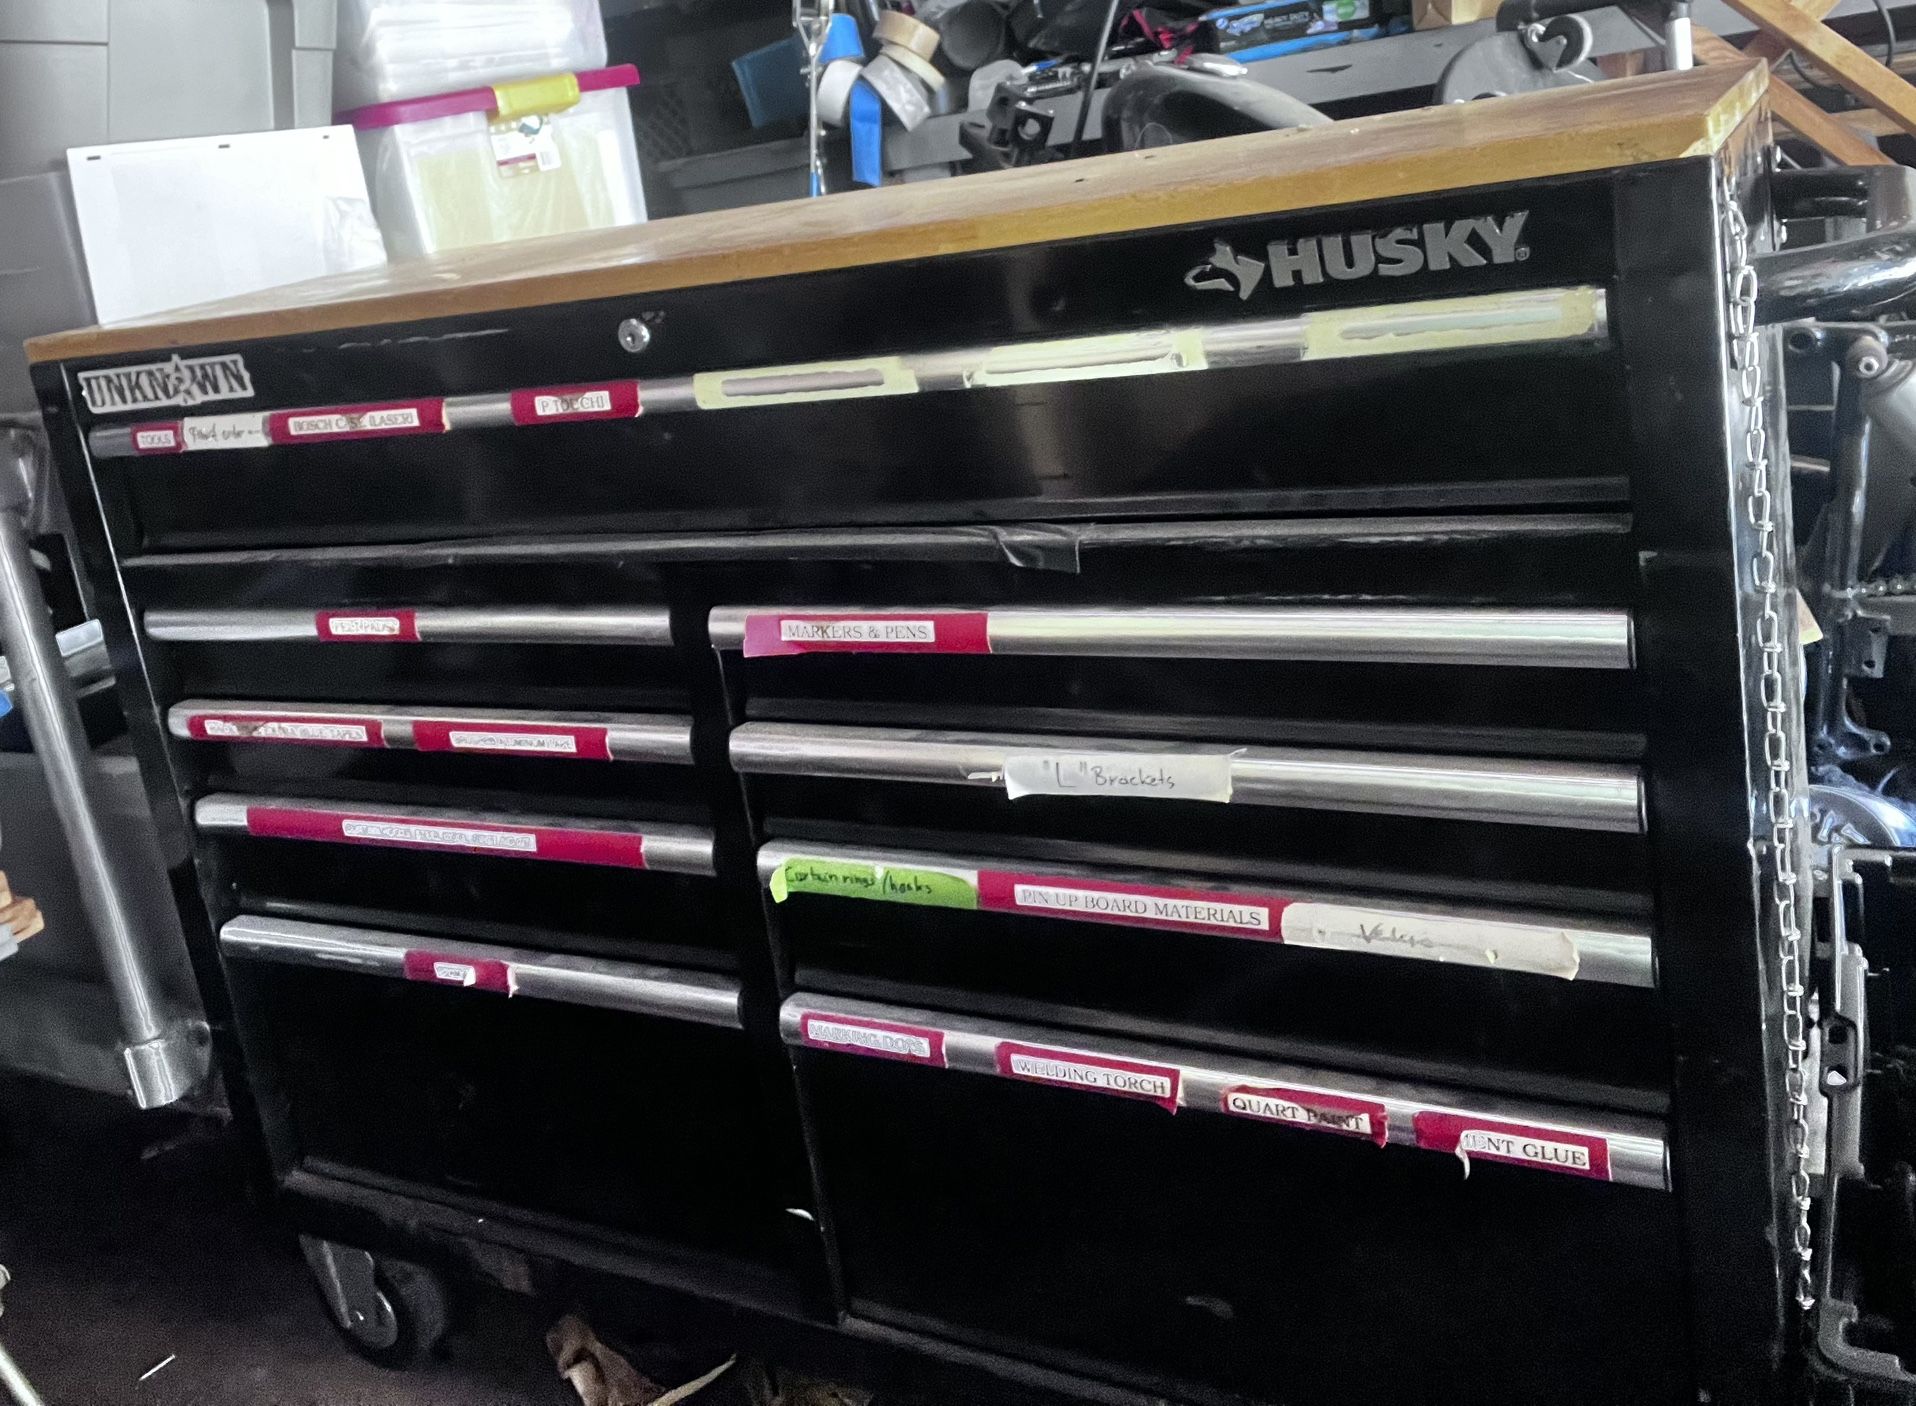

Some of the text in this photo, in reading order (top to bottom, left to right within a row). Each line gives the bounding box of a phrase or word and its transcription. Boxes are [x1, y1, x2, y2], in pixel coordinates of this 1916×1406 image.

[1267, 210, 1529, 288] HUSKY
[787, 624, 928, 639] MARKERS & PENS
[1090, 766, 1176, 789] Brackets
[1020, 888, 1262, 927] PIN UP BOARD MATERIALS
[809, 1023, 879, 1046] MARKING
[1017, 1059, 1166, 1095] WELDING TORCH
[1232, 1097, 1300, 1119] QUART
[1522, 1143, 1587, 1167] GLUE
